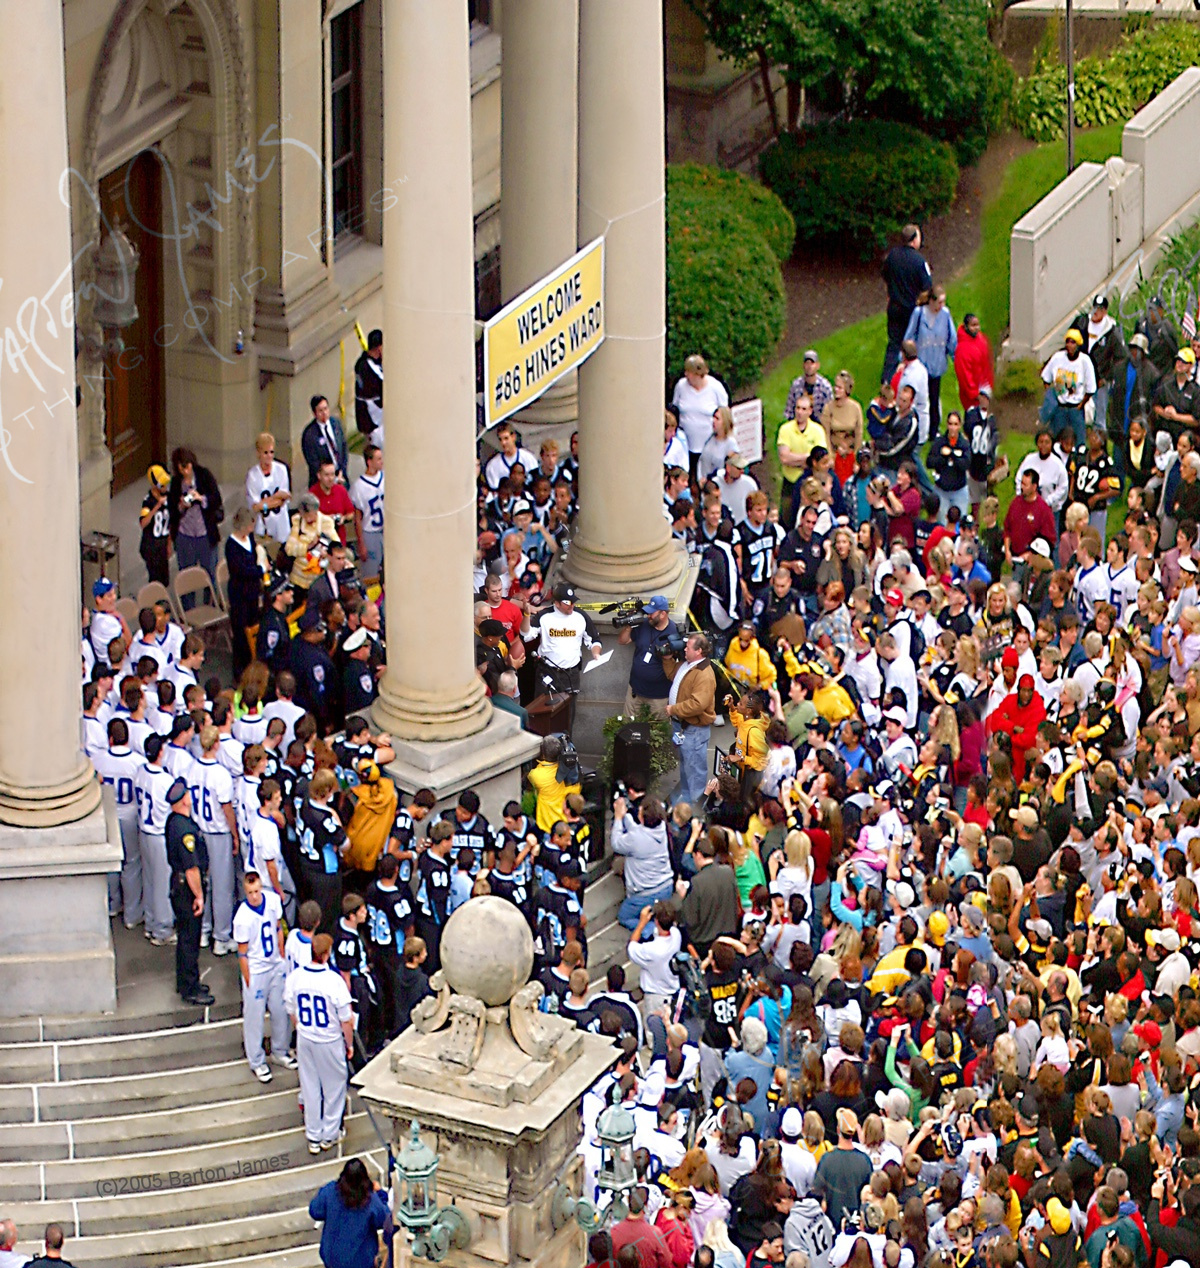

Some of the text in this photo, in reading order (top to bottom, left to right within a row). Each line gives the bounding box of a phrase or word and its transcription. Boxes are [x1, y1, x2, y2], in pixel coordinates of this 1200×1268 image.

[518, 272, 582, 344] WELCOME
[495, 302, 602, 406] #86 HINES WARD
[1077, 466, 1099, 492] 82
[549, 627, 576, 638] Steelers
[261, 921, 273, 957] 6
[297, 993, 329, 1028] 68
